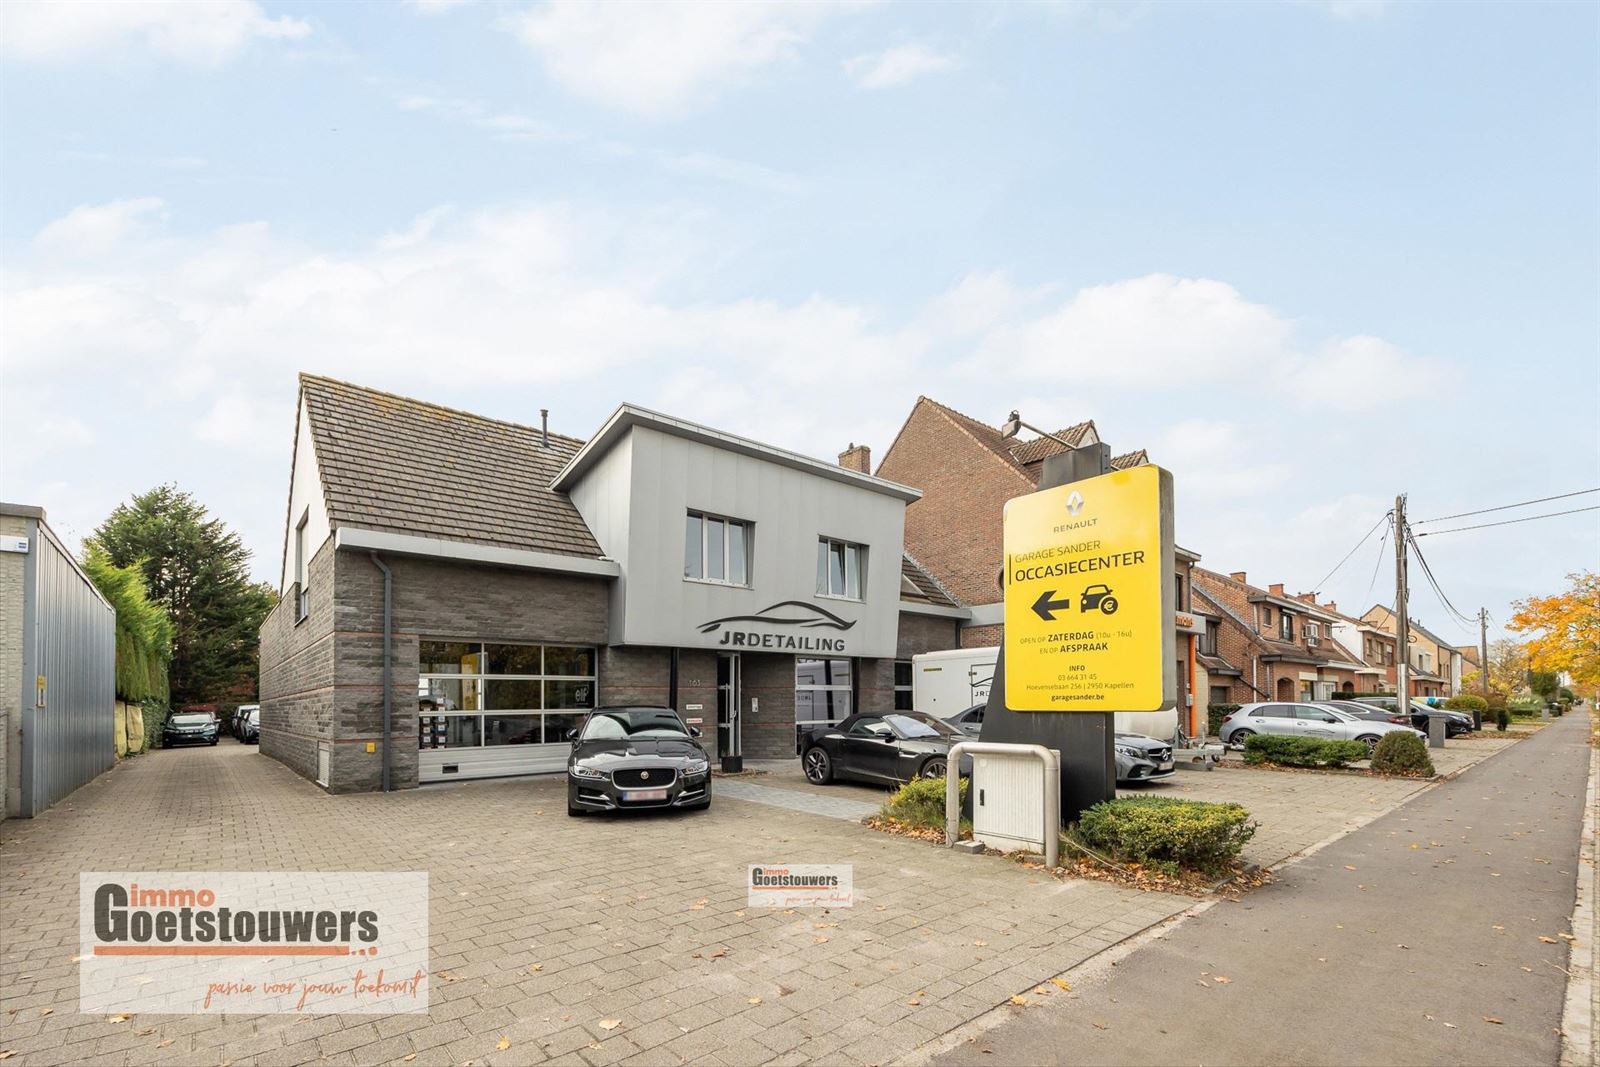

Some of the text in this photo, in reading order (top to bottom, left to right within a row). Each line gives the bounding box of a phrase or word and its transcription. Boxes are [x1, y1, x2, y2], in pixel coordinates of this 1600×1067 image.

[1053, 518, 1098, 533] RENAULT
[1015, 540, 1101, 563] GARAGE SANDER
[1015, 550, 1145, 582] OCCASIECENTER
[1048, 631, 1094, 642] ZATERDAG
[1096, 631, 1111, 640] (10u
[1060, 642, 1108, 653] AFSPRAAK
[1104, 682, 1135, 690] Kapellen
[1051, 693, 1105, 702] garagesander.be
